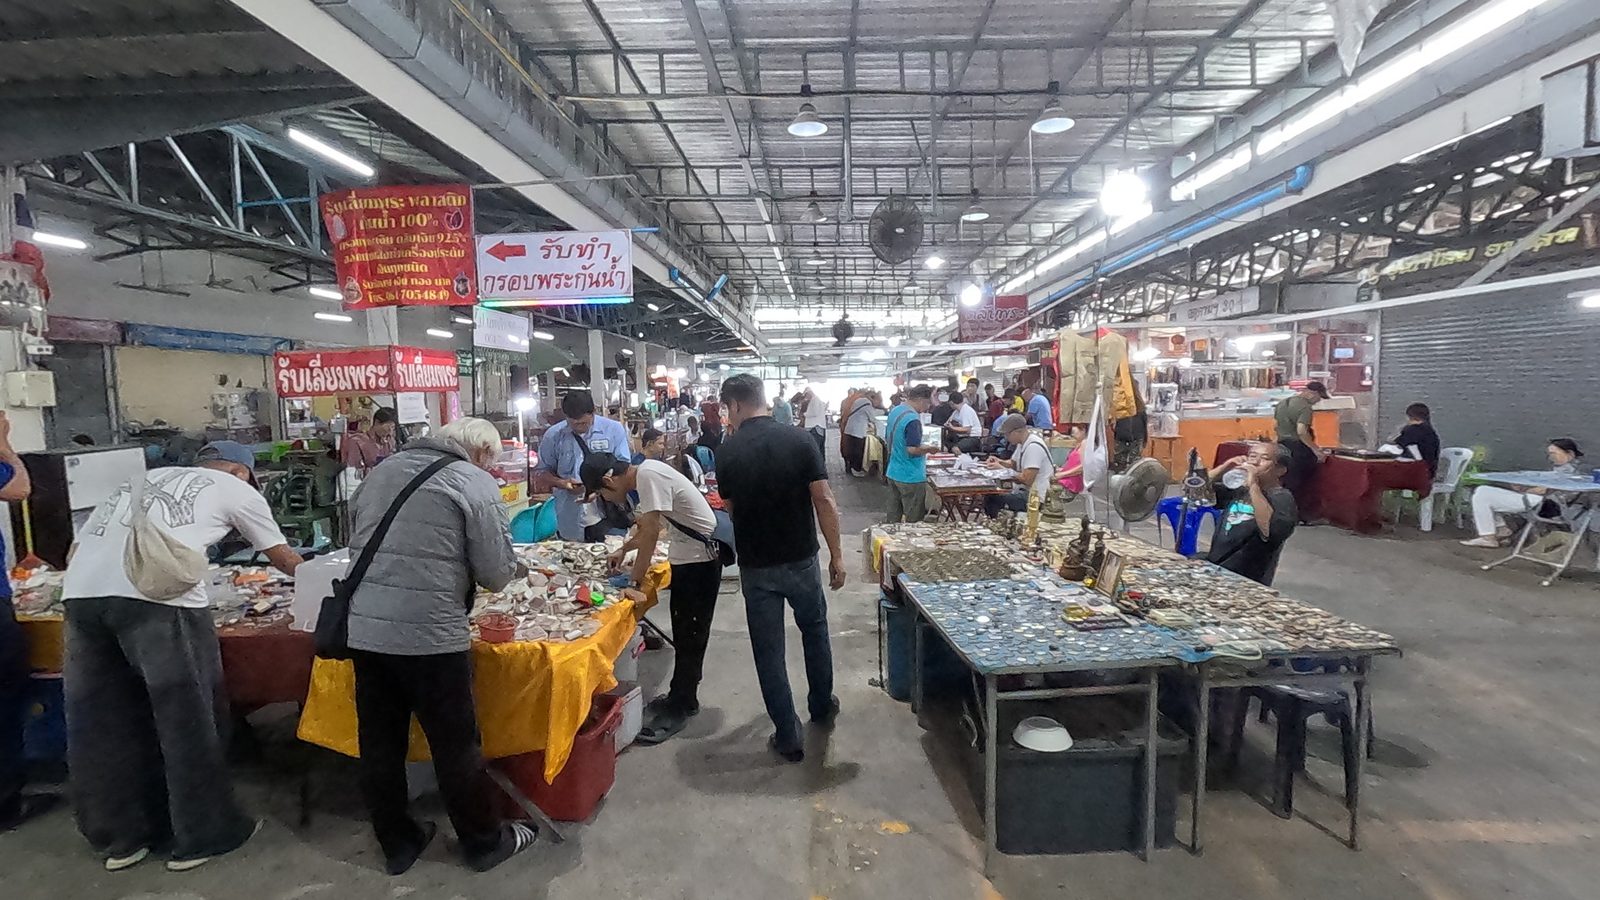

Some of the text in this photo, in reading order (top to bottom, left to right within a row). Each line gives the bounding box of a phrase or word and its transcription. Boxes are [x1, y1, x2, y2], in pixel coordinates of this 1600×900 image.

[409, 192, 467, 208] พลาสติก
[540, 236, 612, 260] รับทำ
[483, 256, 627, 294] กรอบพระกันน้ำ
[278, 353, 389, 393] รับเลี่ยมพระ
[395, 351, 458, 388] รับเลี่ยมพระ
